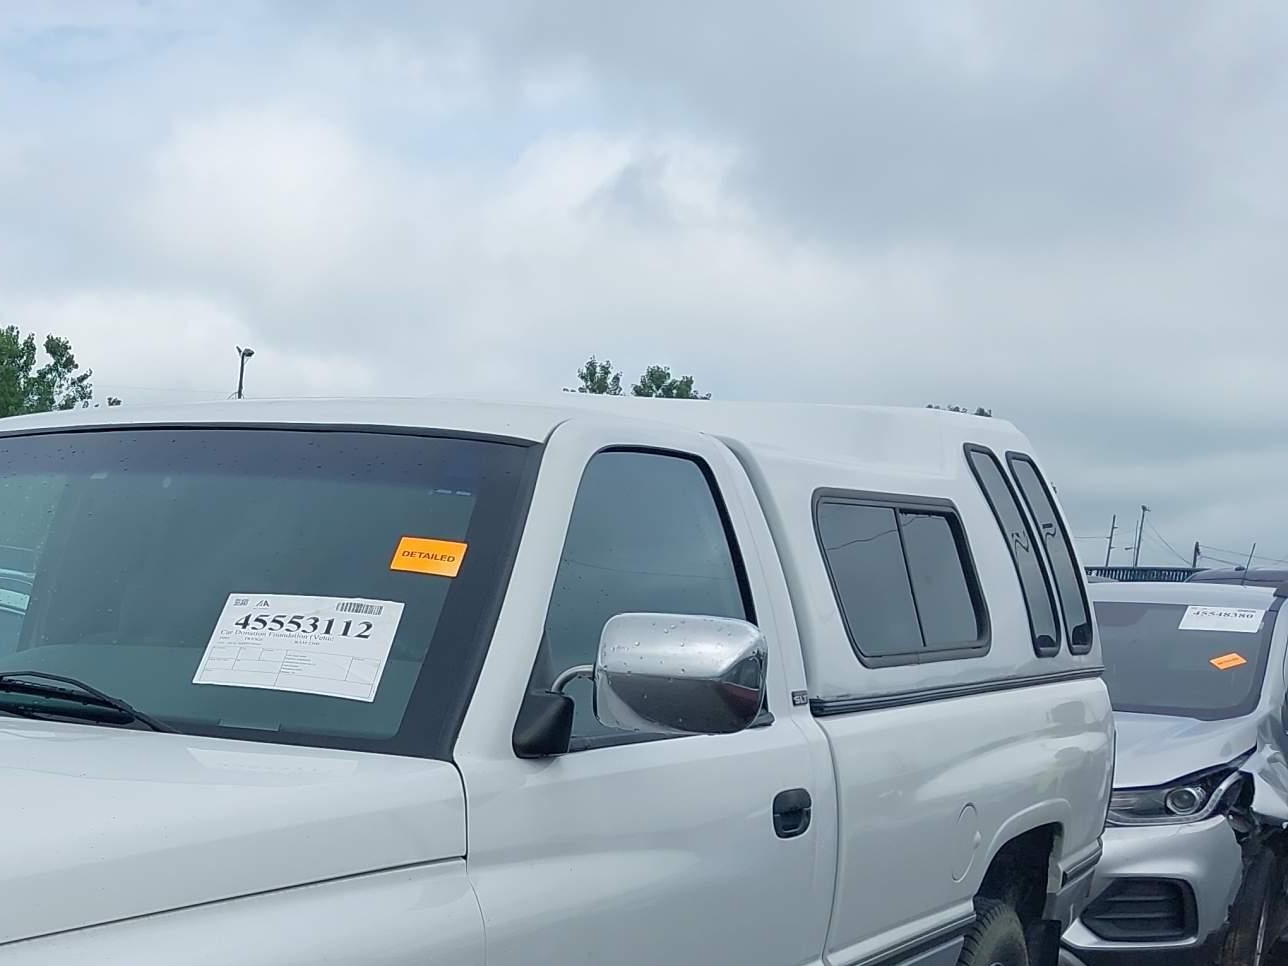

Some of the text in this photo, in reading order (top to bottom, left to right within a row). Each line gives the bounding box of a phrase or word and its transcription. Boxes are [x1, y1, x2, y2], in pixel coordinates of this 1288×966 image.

[401, 550, 456, 563] DETAILED
[234, 613, 373, 640] 45553112
[793, 695, 808, 705] SLT
